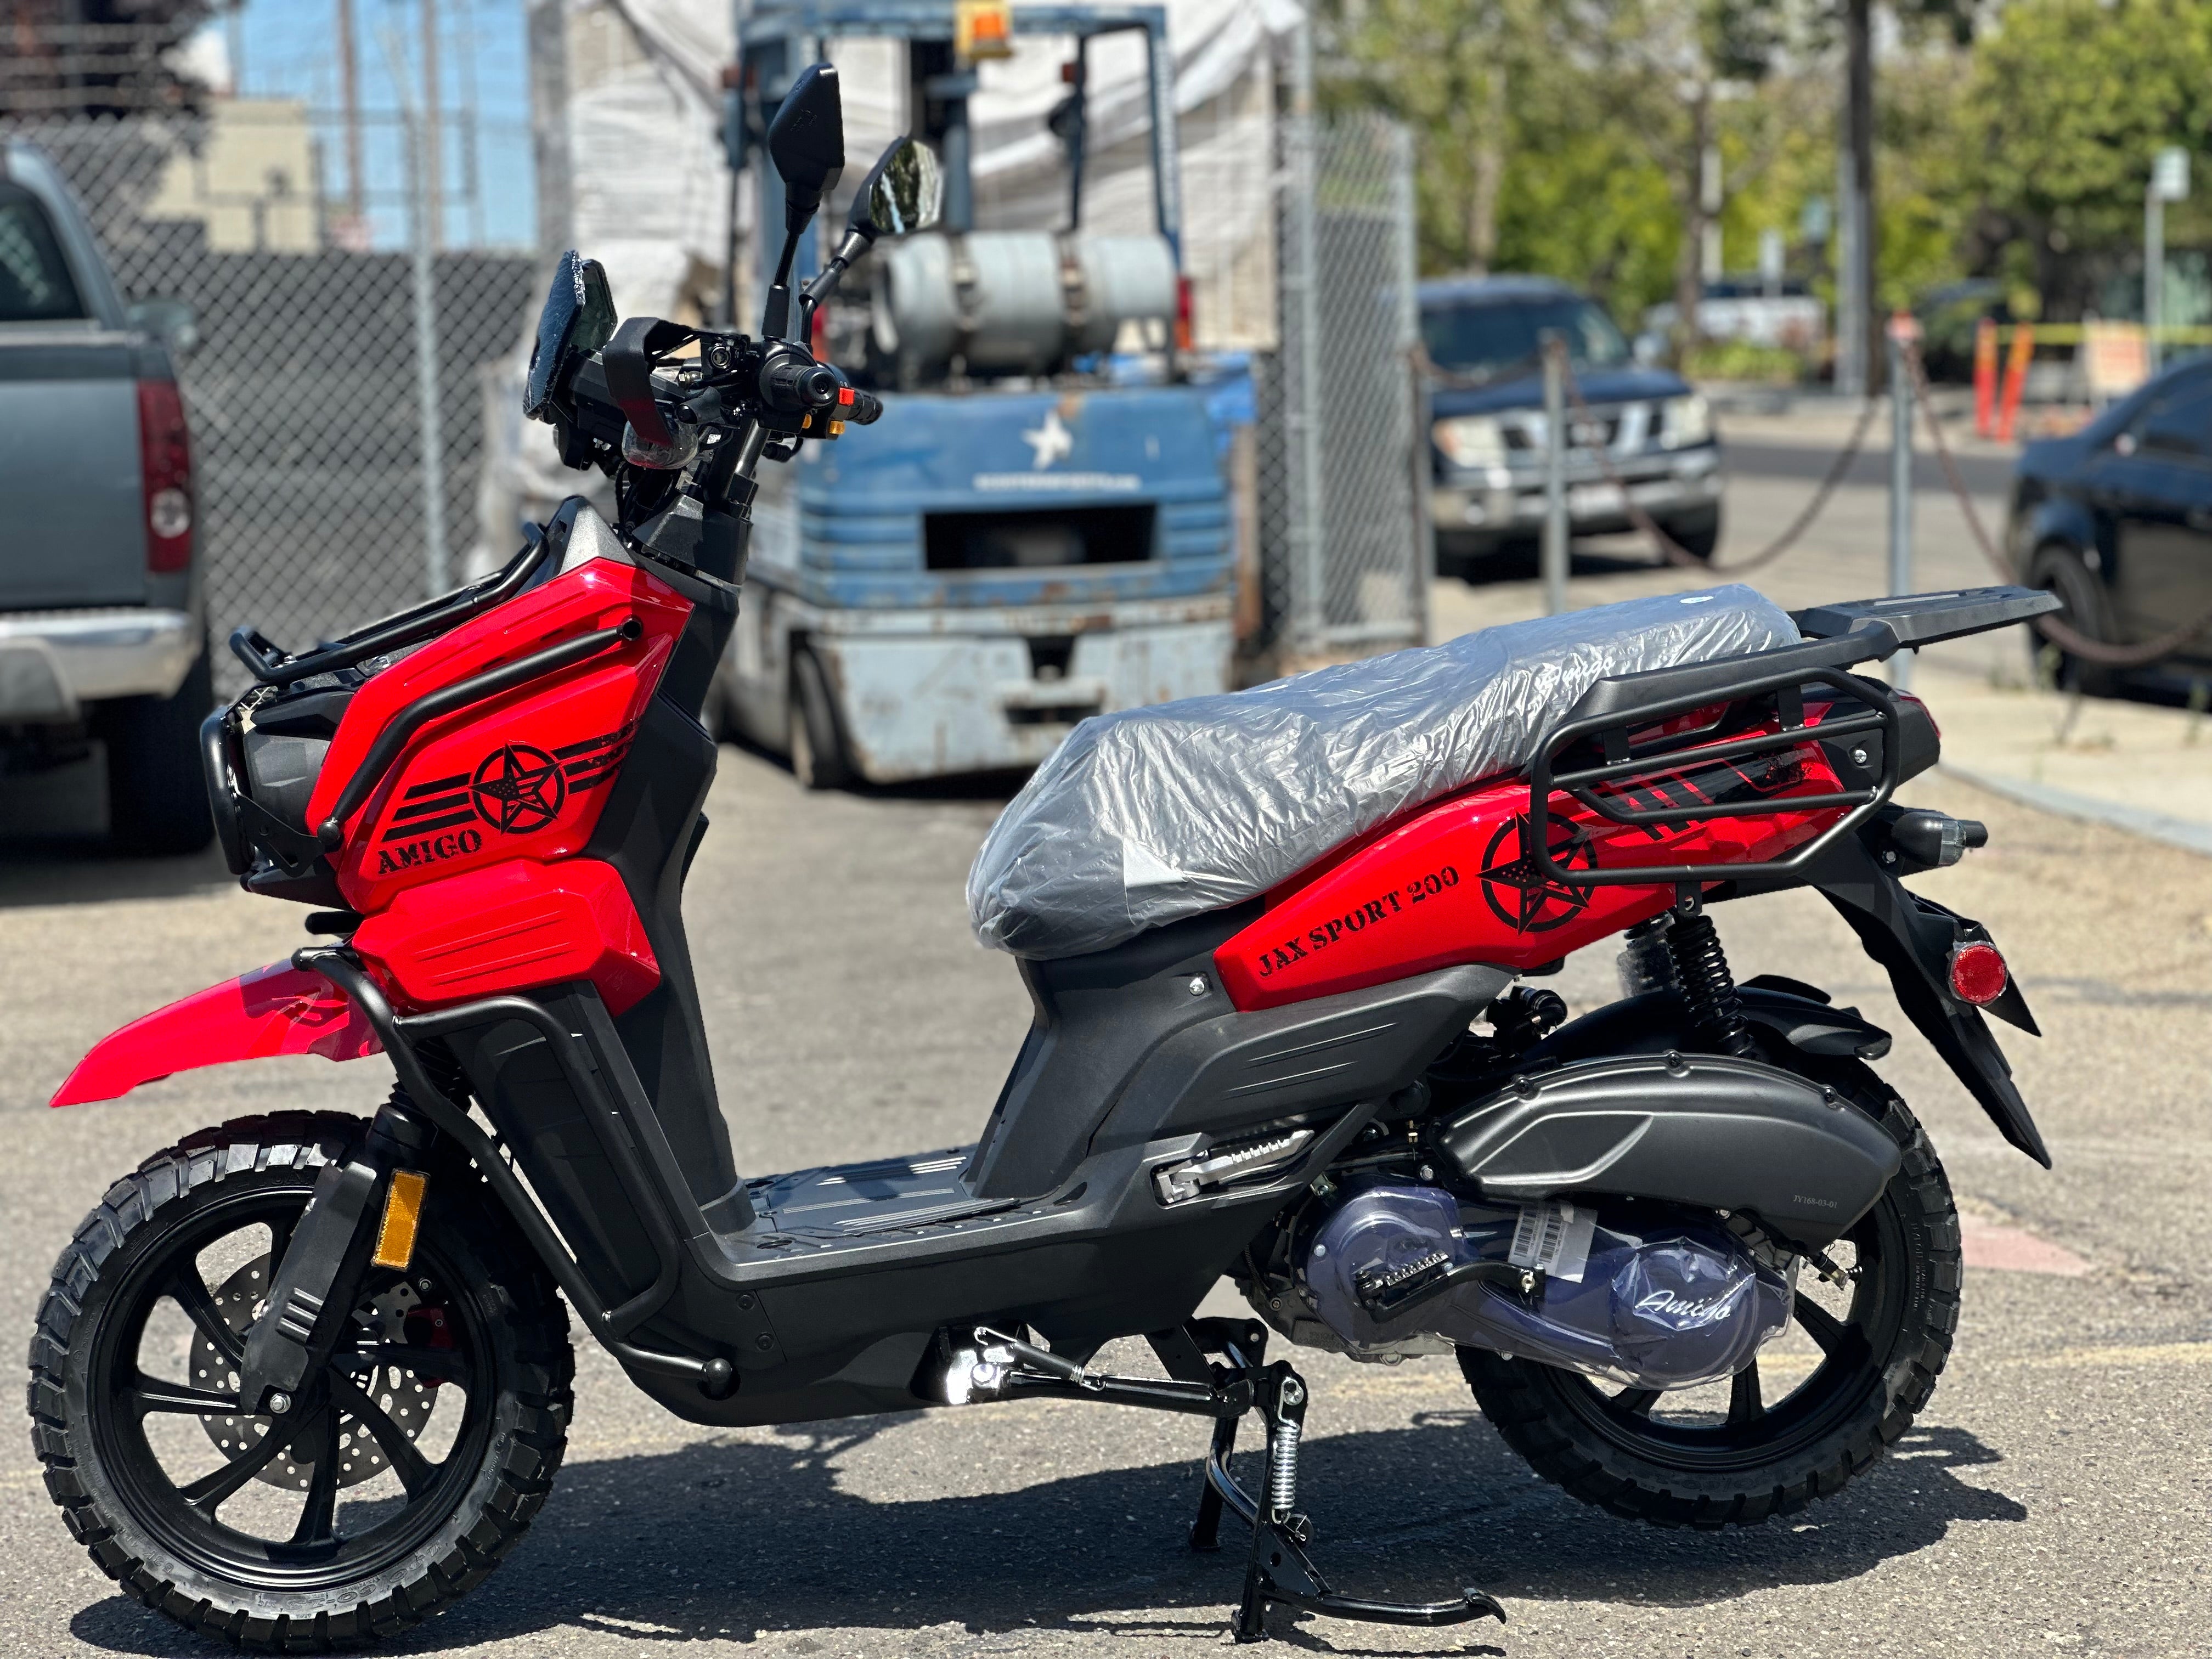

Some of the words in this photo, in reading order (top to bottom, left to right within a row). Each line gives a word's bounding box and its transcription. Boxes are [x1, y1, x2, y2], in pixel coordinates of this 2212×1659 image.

[378, 829, 482, 874] AMIGO
[1259, 937, 1307, 976] JAX
[1308, 890, 1402, 951] SPORT
[1407, 866, 1459, 904] 200
[1793, 1194, 1837, 1209] JY168-03-01
[1634, 1289, 1731, 1324] Amigo
